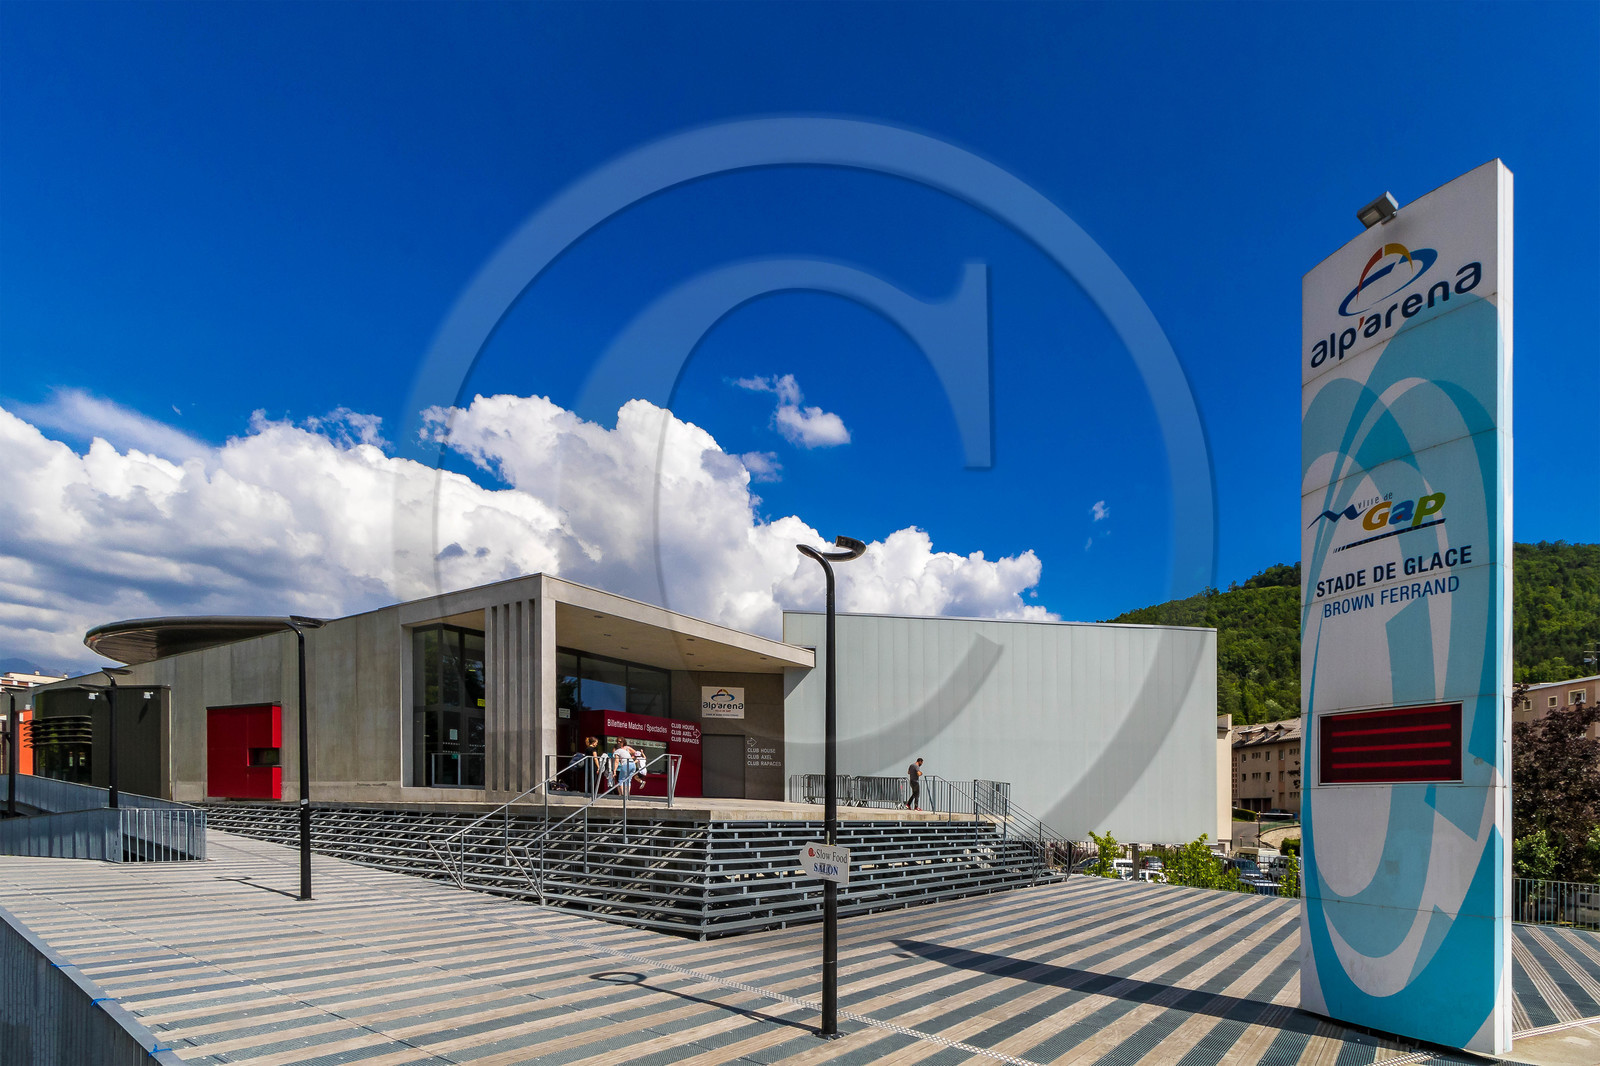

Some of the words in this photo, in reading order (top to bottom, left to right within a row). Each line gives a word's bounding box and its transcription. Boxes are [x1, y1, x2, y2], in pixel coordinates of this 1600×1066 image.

[1310, 261, 1482, 368] alp'arena
[1316, 569, 1366, 598] STADE
[1373, 562, 1396, 583] DE
[1404, 545, 1472, 576] GLACE
[1324, 592, 1374, 619] BROWN
[1380, 575, 1460, 605] FERRAND
[702, 701, 744, 711] alp'arena
[607, 718, 628, 729] Billetterie
[628, 721, 643, 731] Matchs
[646, 723, 667, 733] Spectacles
[816, 849, 831, 859] Slow
[832, 852, 847, 863] Food
[814, 863, 838, 875] SALON
